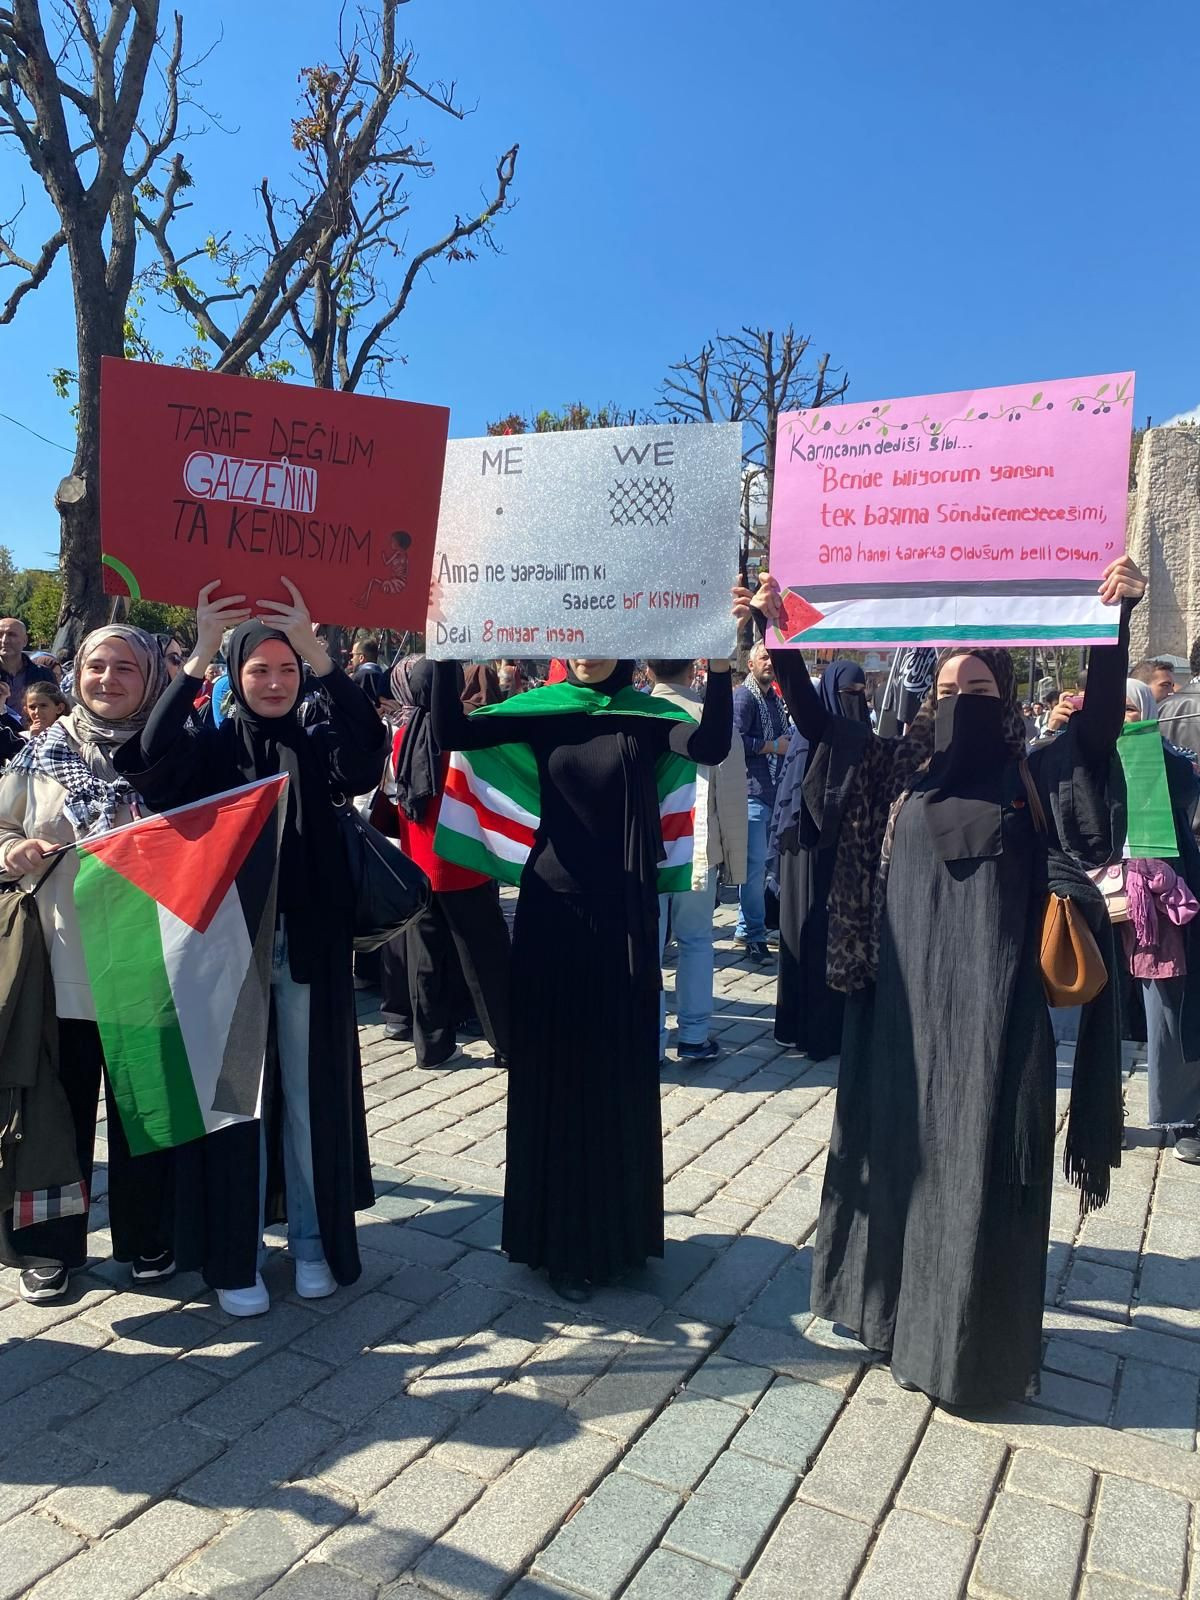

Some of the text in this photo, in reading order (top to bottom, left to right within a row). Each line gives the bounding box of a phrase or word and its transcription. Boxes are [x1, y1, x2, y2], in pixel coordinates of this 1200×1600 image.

[167, 403, 375, 468] TARAF DEĞİLİM
[481, 441, 675, 475] ME WE
[893, 467, 980, 486] biliyorum
[173, 499, 208, 545] TA
[820, 503, 856, 527] tek
[818, 543, 852, 564] ama
[857, 540, 891, 562] hangi
[895, 545, 946, 561] tarafta
[1020, 545, 1052, 561] belli
[485, 564, 505, 582] ne
[511, 564, 590, 582] yapabilirim
[623, 591, 644, 609] bir
[436, 621, 471, 645] Dedi
[482, 619, 494, 643] 8
[496, 626, 540, 643] milyar
